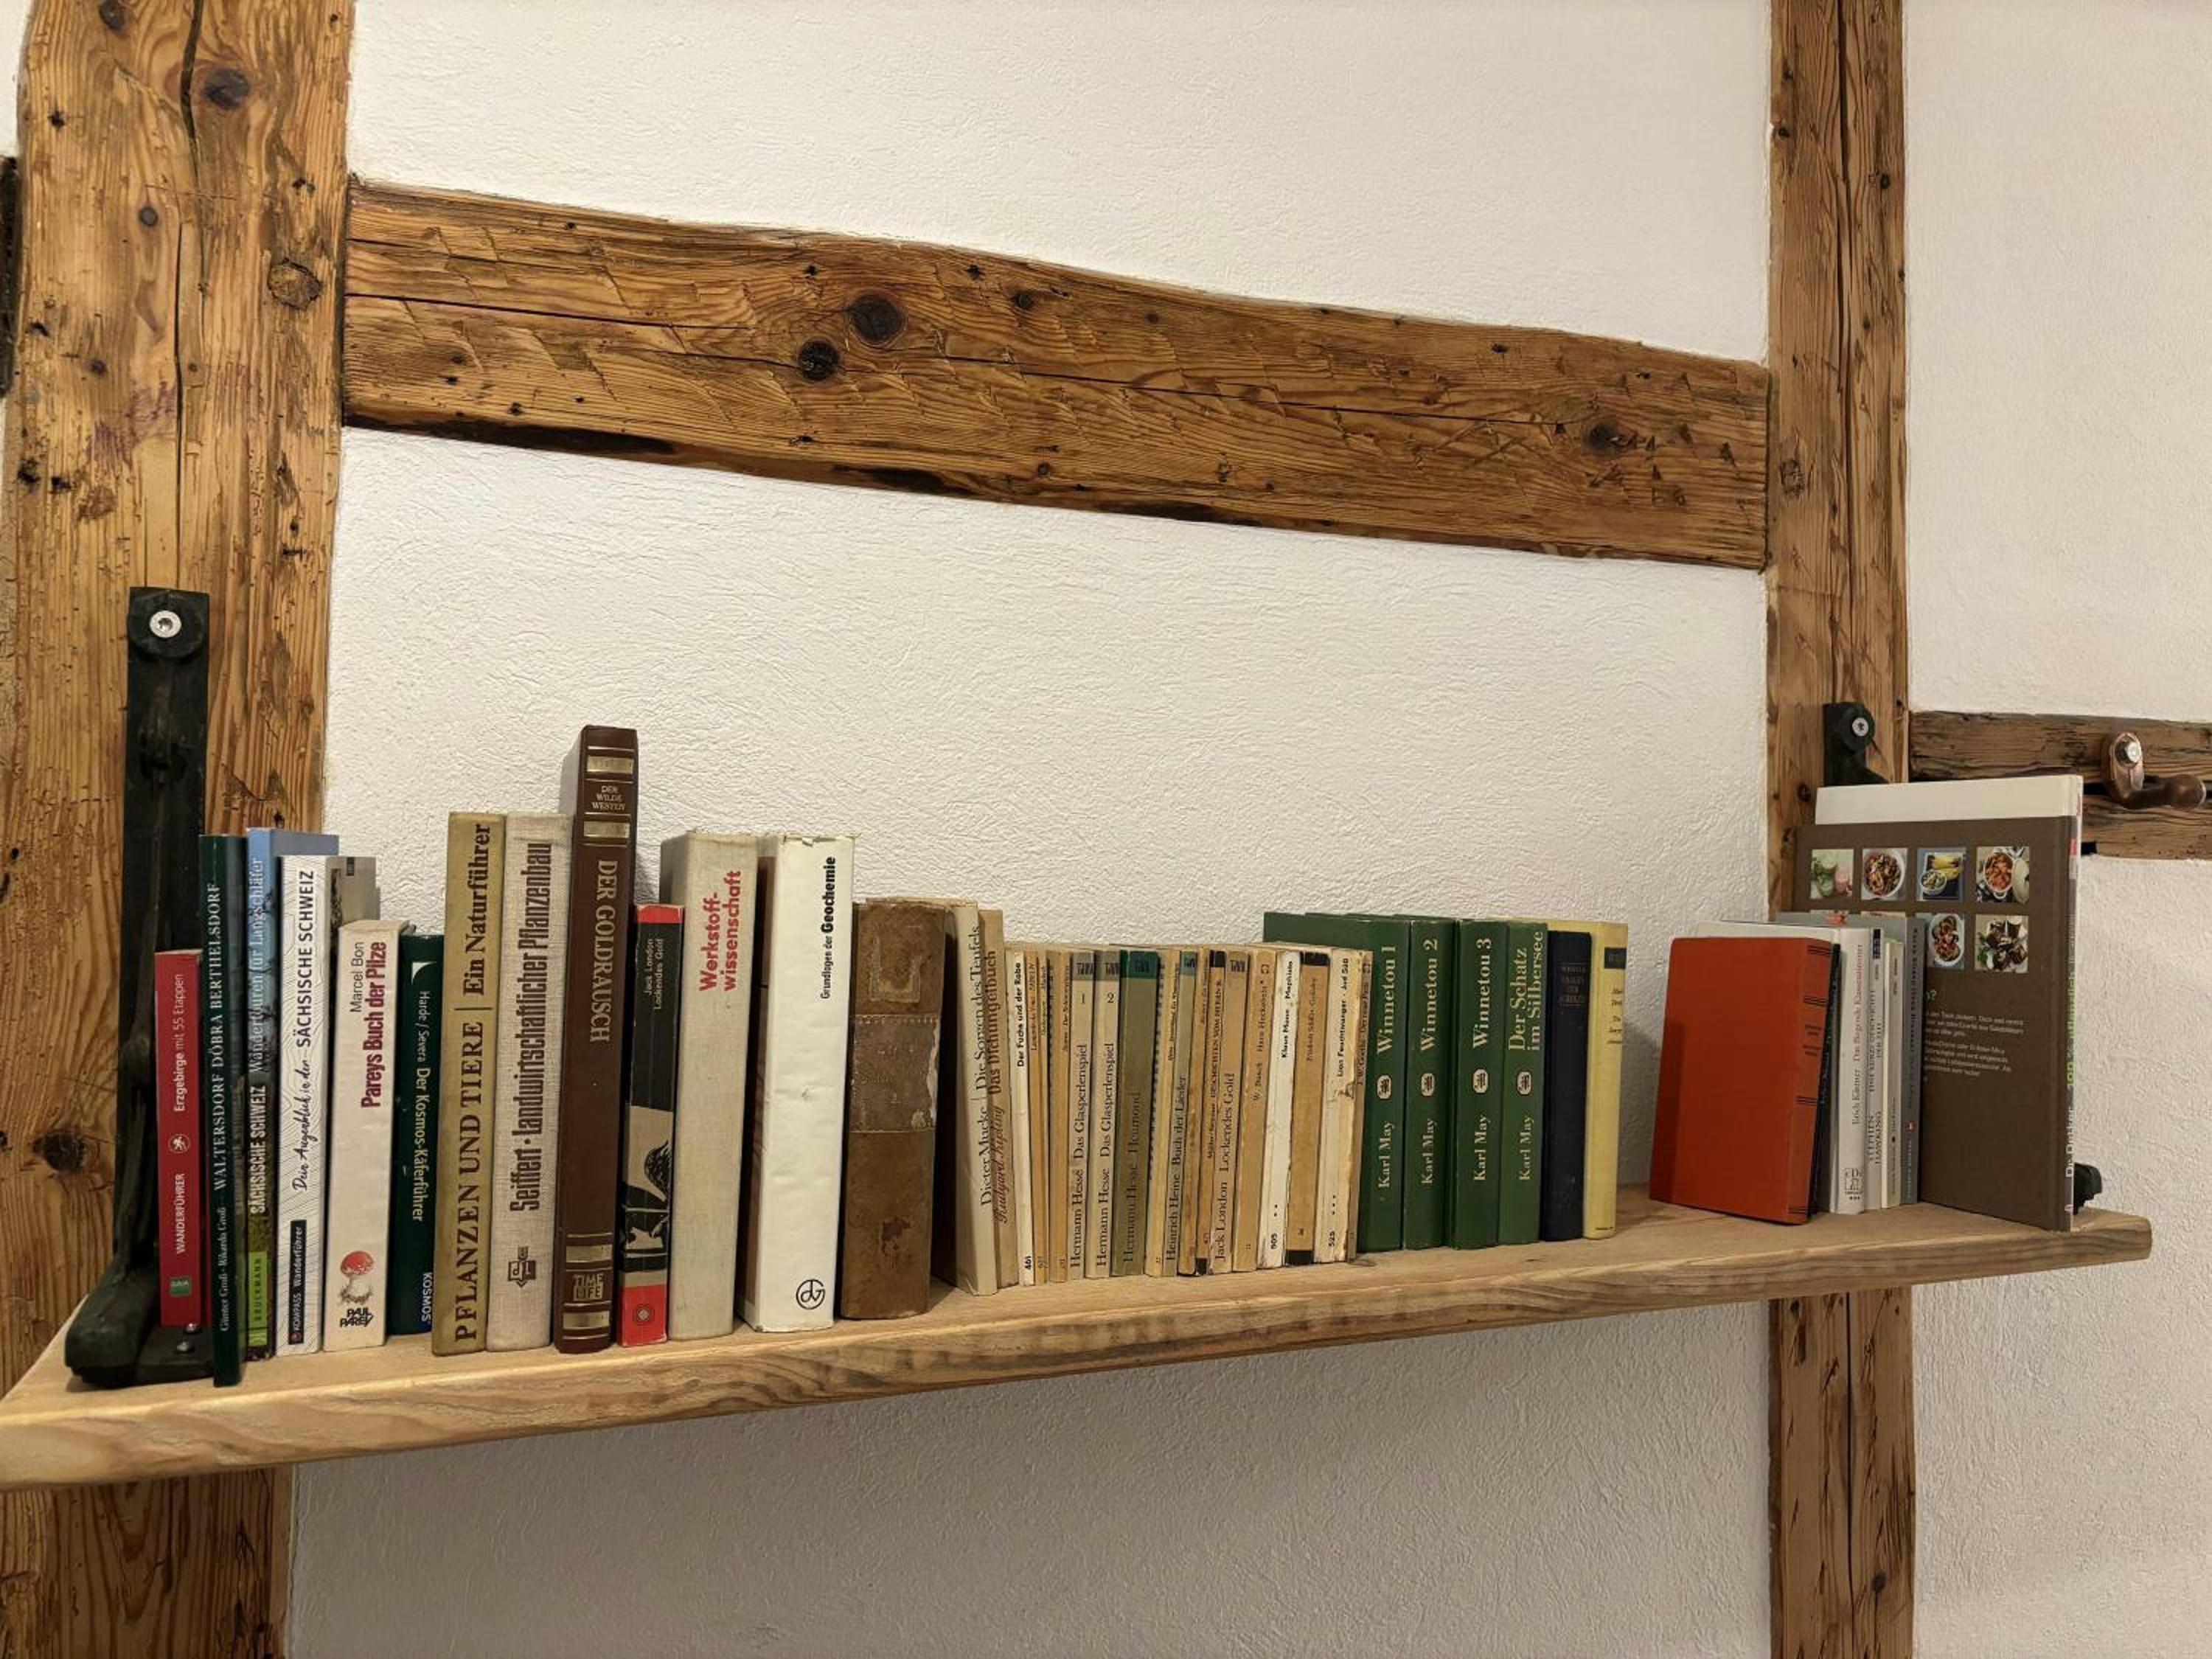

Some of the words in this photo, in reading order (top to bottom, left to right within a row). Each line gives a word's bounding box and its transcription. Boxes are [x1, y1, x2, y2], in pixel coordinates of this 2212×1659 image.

[466, 823, 491, 953] Naturführer
[515, 844, 552, 949] Pflanzenbau
[596, 860, 617, 900] DER
[821, 857, 835, 933] Geochemie
[248, 858, 265, 945] Langschläfer
[299, 870, 313, 941] SCHWEIZ
[208, 883, 221, 1007] BERTHELSDORF
[655, 938, 664, 959] Gold
[699, 892, 720, 991] Werkstoff-
[721, 870, 740, 991] wissenschaft
[823, 936, 832, 948] der
[1423, 938, 1438, 950] 2
[1477, 938, 1492, 948] 3
[248, 951, 263, 970] für
[351, 942, 364, 966] Bon
[366, 942, 386, 978] Pilze
[590, 905, 616, 1042] GOLDRAUSCH
[644, 938, 653, 970] London
[173, 973, 185, 1015] Etappen
[349, 972, 363, 1012] Marcel
[364, 982, 385, 1007] der
[463, 959, 485, 994] Ein
[644, 975, 653, 995] Jack
[653, 963, 663, 1009] Lockendes
[820, 951, 833, 998] Grundlagen
[970, 982, 982, 1005] des
[1014, 988, 1022, 1001] der
[1511, 947, 1528, 1009] Schatz
[1528, 931, 1544, 1018] Silbersee
[294, 948, 313, 1047] SÄCHSISCHE
[417, 991, 429, 1020] Harde
[1015, 1005, 1023, 1020] und
[1107, 992, 1114, 1004] 2
[1377, 959, 1396, 1053] Winnetou
[1421, 958, 1438, 1050] Winnetou
[1473, 954, 1491, 1048] Winnetou
[173, 1017, 184, 1029] 55
[173, 1033, 184, 1049] mit
[211, 1015, 224, 1067] DÖBRA
[248, 975, 264, 1072] Wandertouren
[364, 1012, 383, 1050] Buch
[1338, 1000, 1346, 1057] Feuchtwanger
[1509, 1013, 1526, 1050] Der
[1528, 1026, 1541, 1050] im
[417, 1031, 429, 1062] Severa
[462, 1022, 482, 1107] TIERE
[510, 954, 549, 1135] Landwirtschaftlicher
[173, 1052, 187, 1111] Erzgebirge
[295, 1060, 310, 1079] der
[361, 1054, 385, 1107] Pareys
[414, 1068, 430, 1090] Der
[975, 1063, 987, 1090] Die
[987, 1069, 1001, 1094] Das
[1074, 1044, 1088, 1133] Glasperlenspiel
[1102, 1043, 1115, 1131] Glasperlenspiel
[1224, 1073, 1234, 1103] Gold
[251, 1085, 266, 1137] SCHWEIZ
[1175, 1076, 1186, 1110] Lieder
[212, 1074, 227, 1190] WALTERSDORF
[292, 1096, 317, 1159] Augenblick
[459, 1114, 481, 1174] UND
[991, 1106, 1007, 1158] Kipling
[1074, 1137, 1084, 1158] Das
[1100, 1134, 1110, 1156] Das
[1220, 1107, 1232, 1171] Lockendes
[1379, 1121, 1395, 1149] May
[1422, 1118, 1436, 1146] May
[1475, 1113, 1491, 1143] May
[1520, 1115, 1535, 1143] May
[411, 1094, 430, 1221] Kosmos-Käferführer
[1171, 1136, 1181, 1165] Buch
[1422, 1152, 1433, 1183] Karl
[1474, 1149, 1486, 1180] Karl
[1520, 1148, 1531, 1180] Karl
[249, 1142, 265, 1213] SÄCHSISCHE
[292, 1164, 307, 1190] Dein
[509, 1149, 541, 1211] Seiffert
[1072, 1169, 1083, 1205] Hesse
[1099, 1168, 1109, 1203] Hesse
[1169, 1174, 1180, 1207] Heine
[1379, 1155, 1391, 1187] Karl
[992, 1161, 1009, 1223] Rudyard
[1217, 1181, 1227, 1230] London
[173, 1173, 186, 1253] WANDERFÜHRER
[1124, 1203, 1135, 1262] Hermann
[1071, 1208, 1081, 1267] Hermann
[1097, 1206, 1107, 1265] Hermann
[1166, 1211, 1177, 1259] Heinrich
[1215, 1235, 1225, 1259] Jack
[293, 1225, 303, 1286] Wanderführer
[456, 1183, 479, 1340] PFLANZEN
[293, 1293, 301, 1330] KOMPASS
[421, 1272, 433, 1322] KOSMOS
